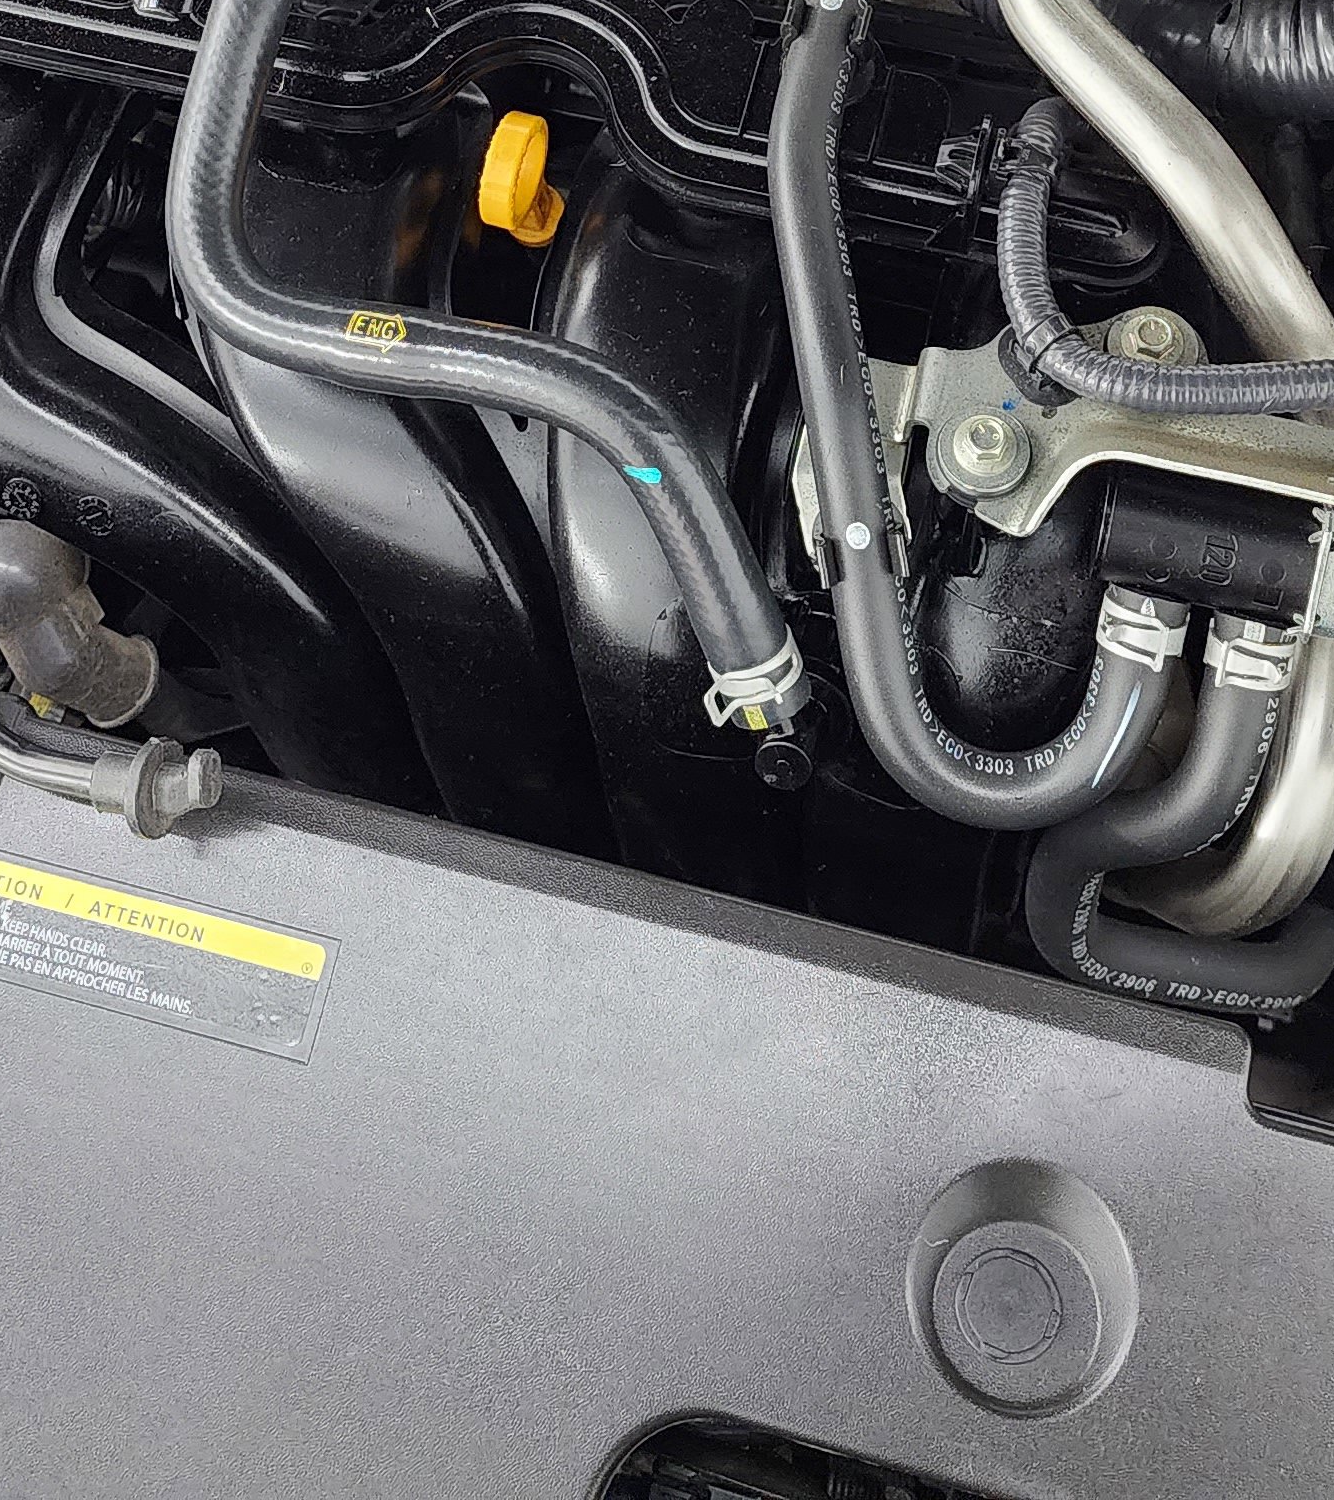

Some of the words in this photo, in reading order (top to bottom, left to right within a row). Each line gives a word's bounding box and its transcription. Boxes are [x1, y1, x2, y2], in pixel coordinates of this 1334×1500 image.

[353, 316, 396, 340] ENG
[1199, 534, 1239, 586] 120
[0, 916, 28, 937] KEEP
[28, 923, 70, 948] HANDS
[68, 934, 109, 959] CLEAR.
[87, 897, 206, 944] ATTENTION
[8, 952, 33, 972] PAS
[33, 958, 52, 977] EN
[50, 963, 126, 997] APPROCHER
[125, 983, 150, 1003] LES
[148, 989, 196, 1015] MAINS.
[50, 946, 86, 969] TOUT
[85, 956, 147, 985] MOMENT.
